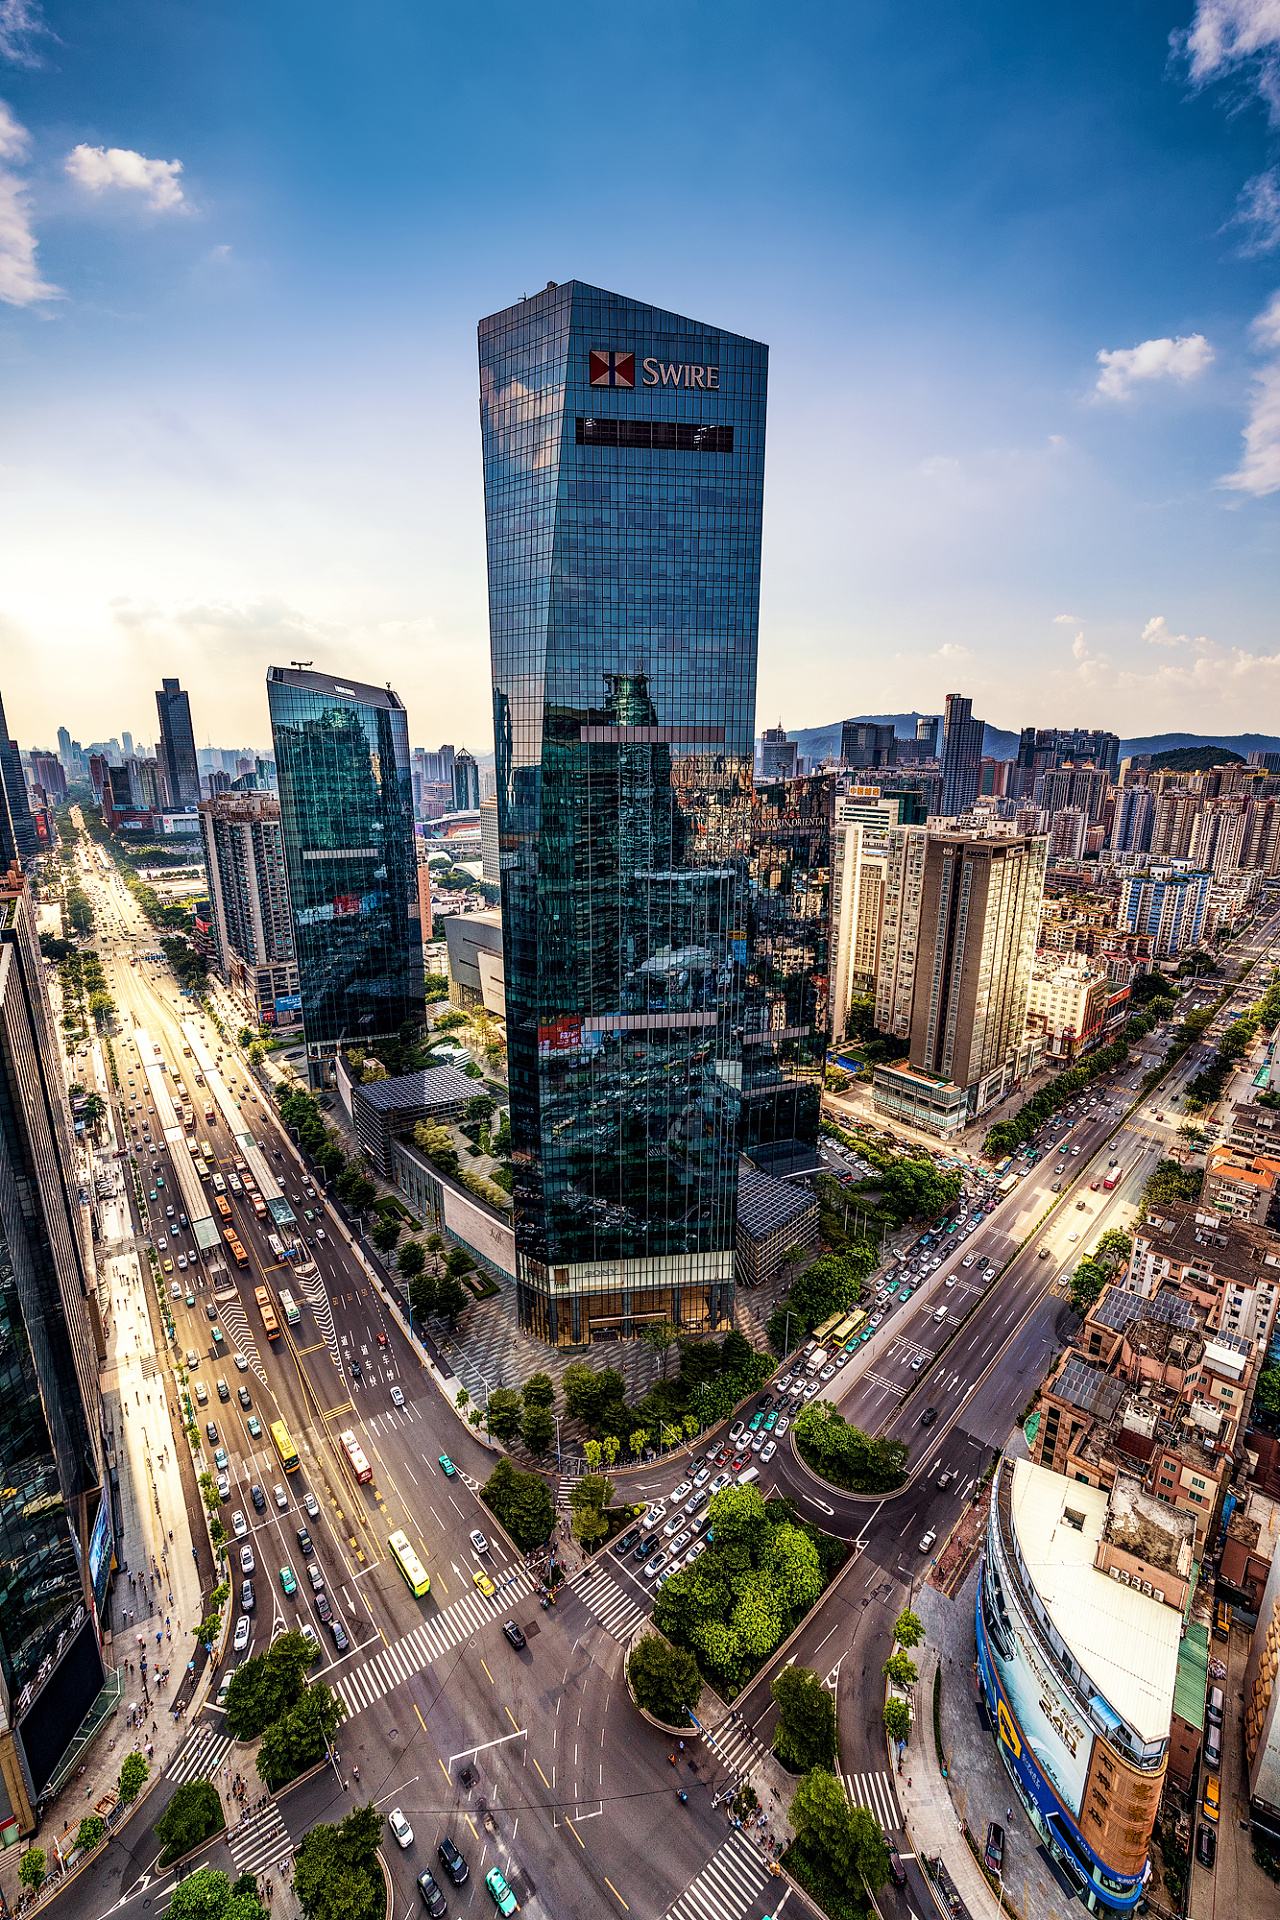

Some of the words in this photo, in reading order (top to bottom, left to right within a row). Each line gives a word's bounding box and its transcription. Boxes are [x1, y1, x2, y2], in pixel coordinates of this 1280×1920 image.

[642, 358, 720, 389] SWIRE
[750, 818, 791, 828] MANDARIN
[791, 817, 828, 827] ORIENTAL
[585, 1269, 617, 1278] SONY
[1041, 1694, 1078, 1752] 240
